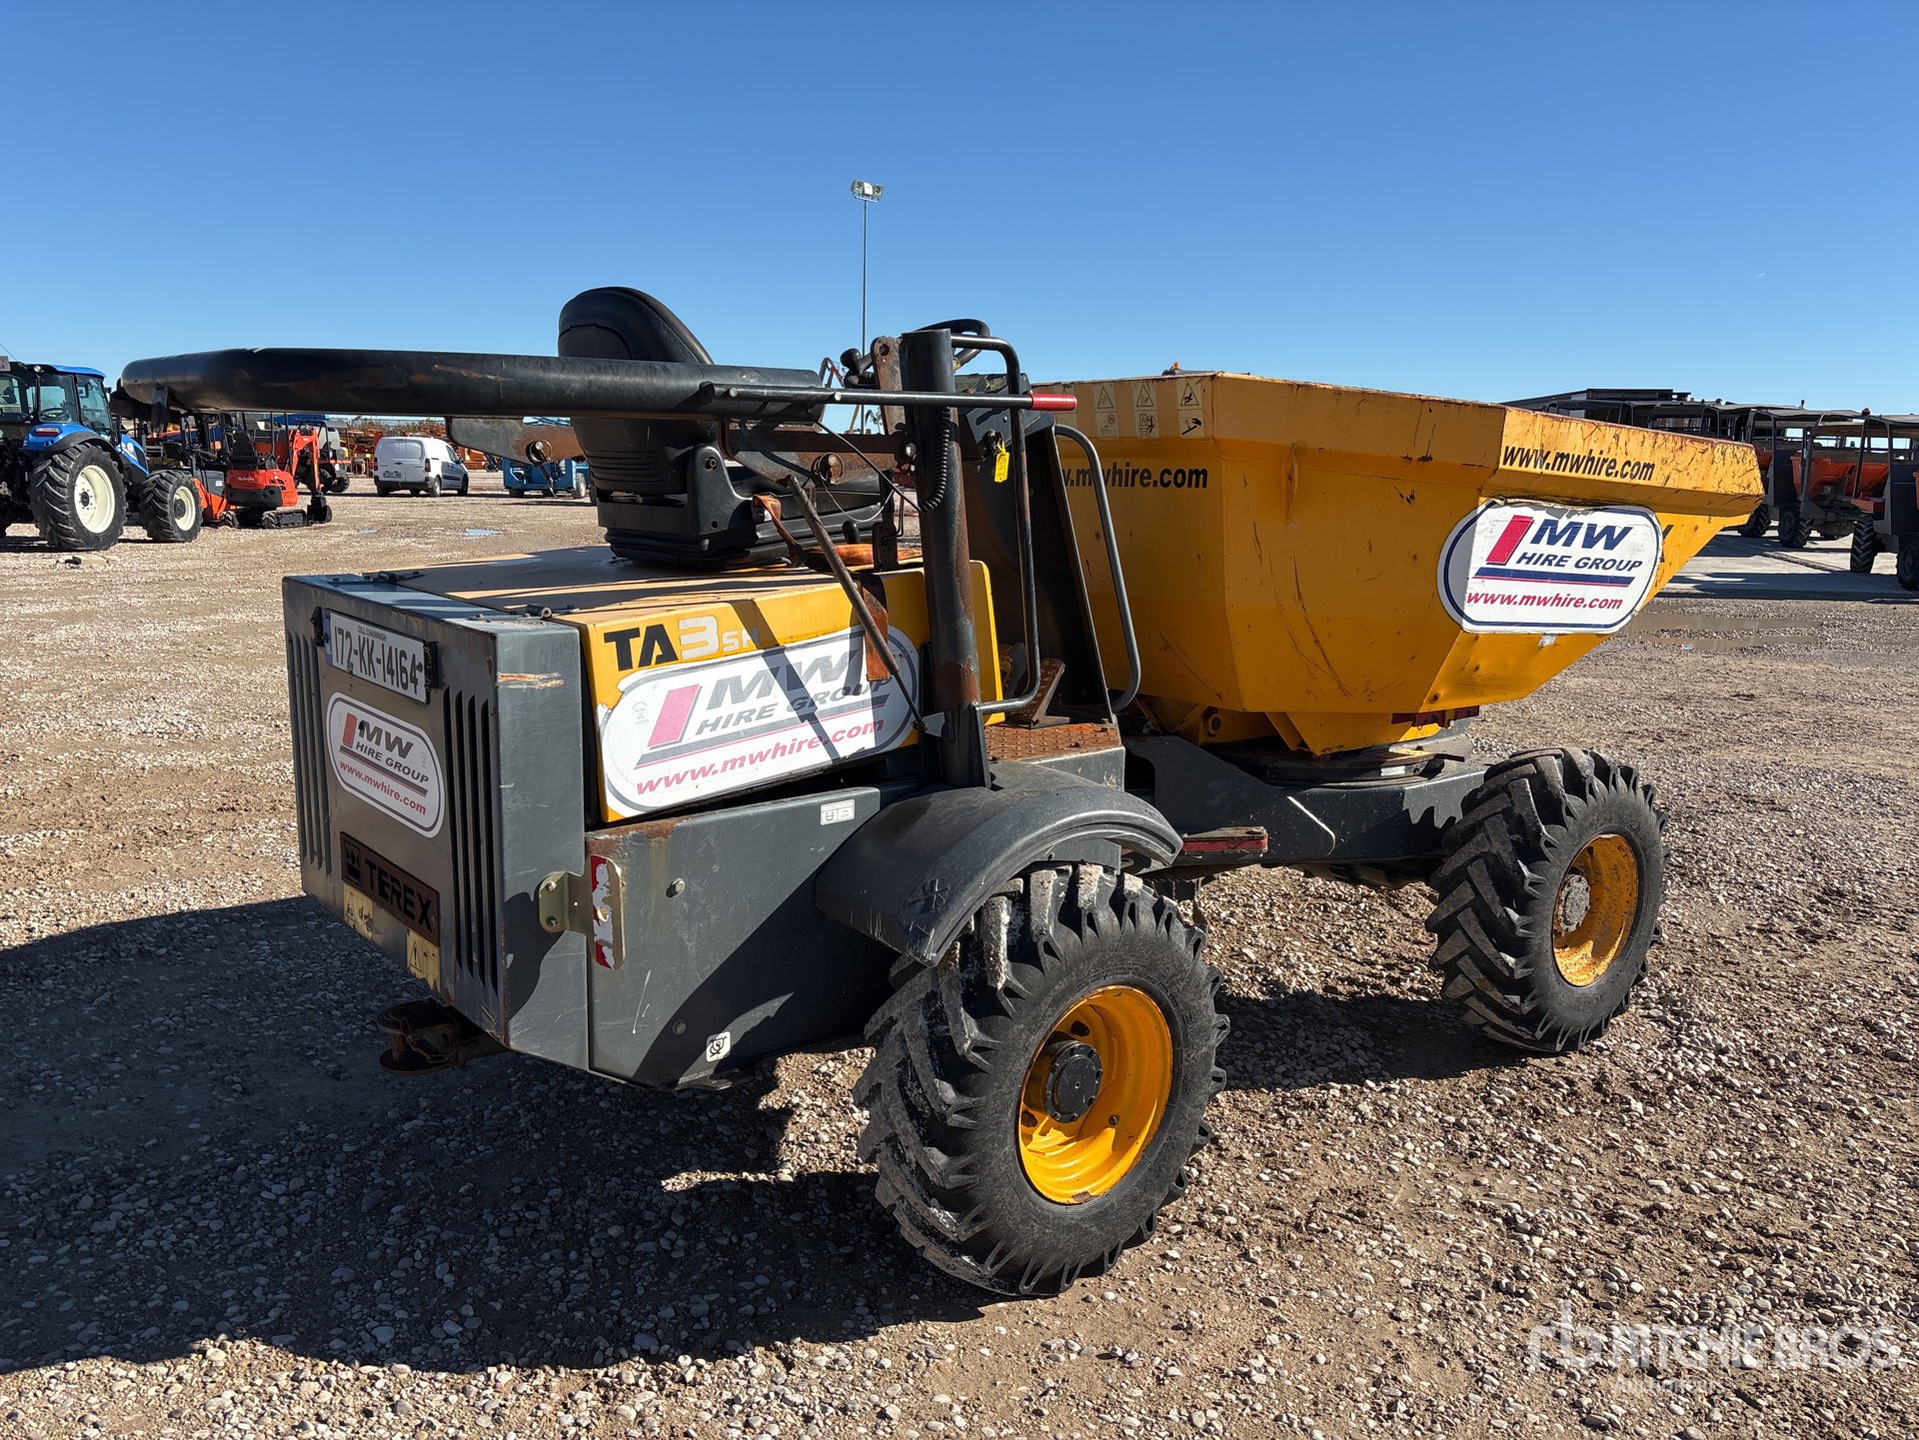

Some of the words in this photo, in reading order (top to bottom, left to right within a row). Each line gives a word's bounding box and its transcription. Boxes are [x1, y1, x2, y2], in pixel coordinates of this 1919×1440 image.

[1502, 445, 1656, 481] www.mwhire.com
[1530, 518, 1634, 550] MW
[1516, 552, 1572, 568] HIRE
[1574, 557, 1643, 573] GROUP
[1466, 592, 1624, 610] www.mwhire.com
[334, 625, 424, 695] 172-KK-14164
[706, 651, 856, 711] MW
[696, 703, 778, 735] HIRE
[786, 679, 893, 714] GROUP
[355, 742, 384, 762] HIRE
[385, 757, 430, 783] GROUP
[358, 719, 414, 759] MW
[636, 718, 884, 795] www.mwhire.com
[339, 761, 427, 815] www.mwhire.com
[365, 858, 432, 932] TEREX
